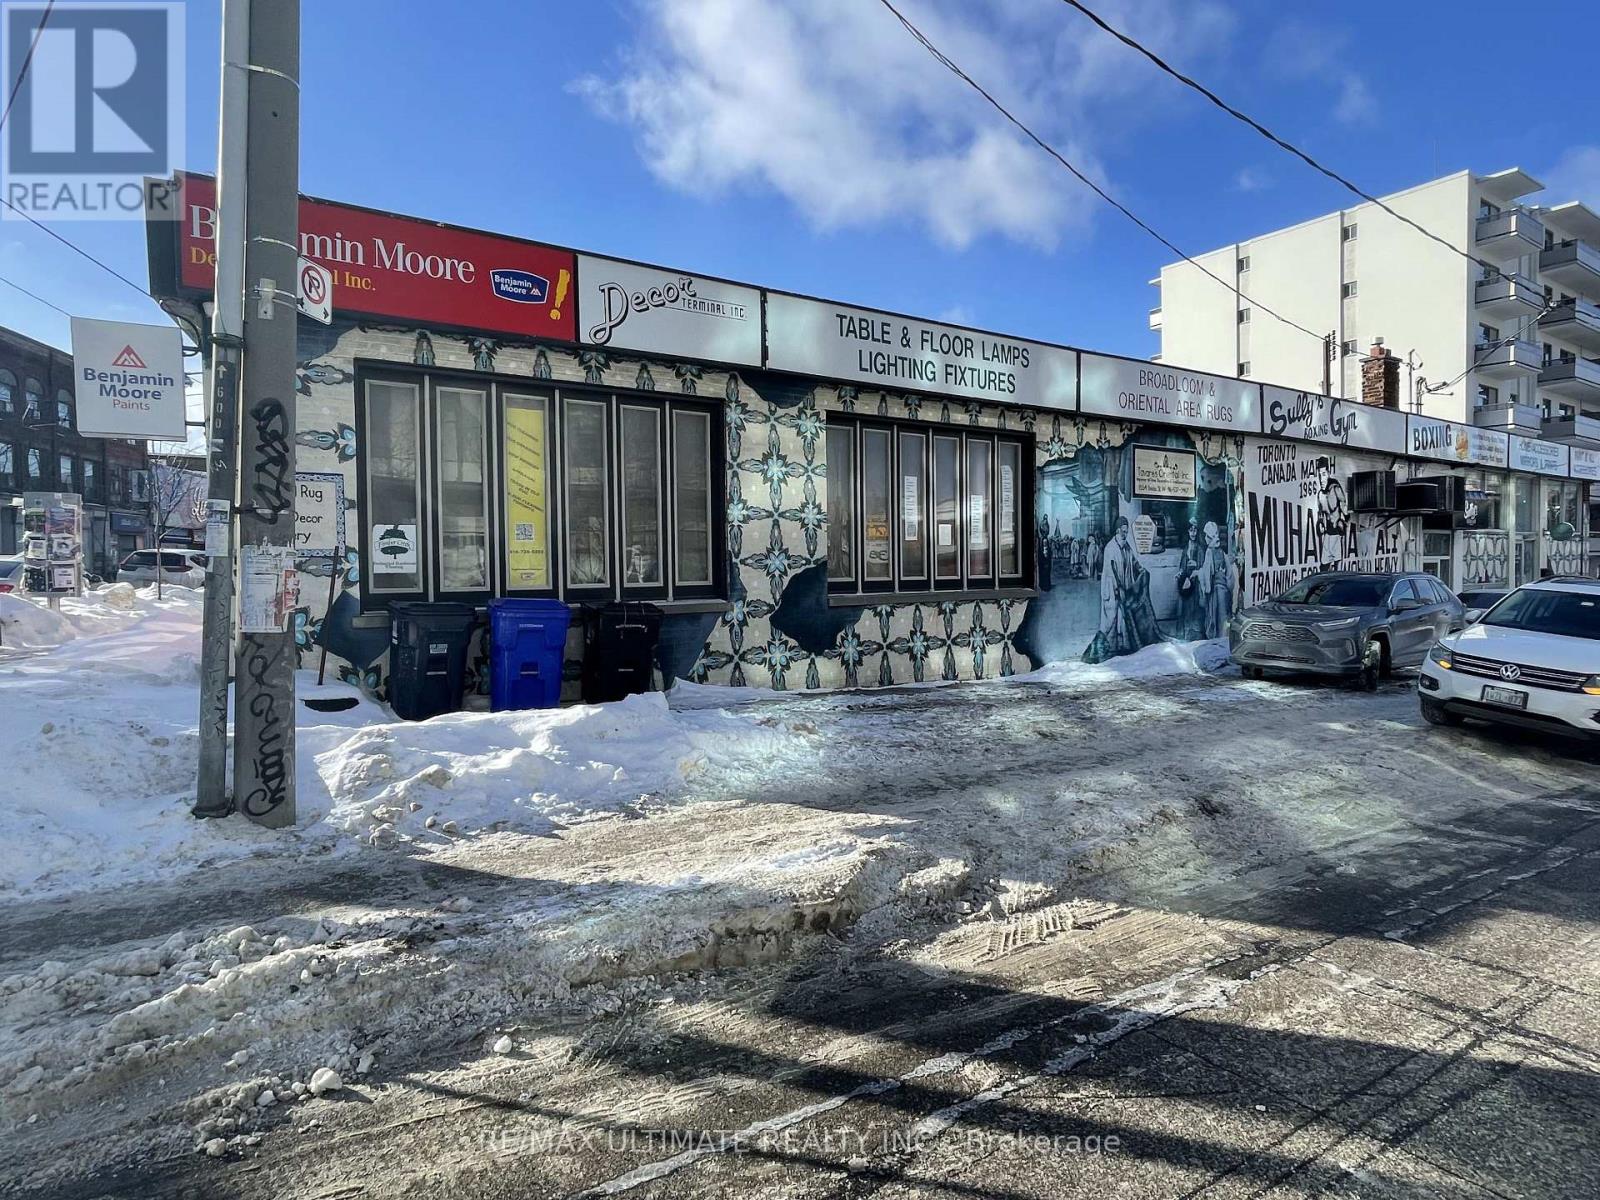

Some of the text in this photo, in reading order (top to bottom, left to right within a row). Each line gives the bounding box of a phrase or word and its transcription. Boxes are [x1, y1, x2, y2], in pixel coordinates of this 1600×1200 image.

[373, 237, 476, 284] Moore
[344, 271, 377, 291] Inc.
[494, 274, 533, 288] Benjamin
[500, 283, 527, 295] Moore
[588, 277, 697, 345] Decor
[681, 297, 726, 315] TERMINAL
[836, 313, 1030, 369] TABLE & FLOOR LAMPS
[83, 367, 175, 387] Benjamin
[858, 349, 1017, 394] LIGHTING FIXTURES
[1139, 369, 1216, 397] BROADLOOM &
[99, 383, 162, 400] Moore
[112, 398, 151, 411] Paints
[1118, 391, 1233, 423] ORIENTAL AREA RUGS
[1329, 398, 1358, 446] Gym
[1413, 423, 1453, 452] BOXING
[1257, 444, 1297, 465] TORONTO
[1261, 462, 1298, 487] CANADA
[300, 484, 323, 503] Rug
[1299, 480, 1318, 499] 1966
[1375, 529, 1398, 556] ALI
